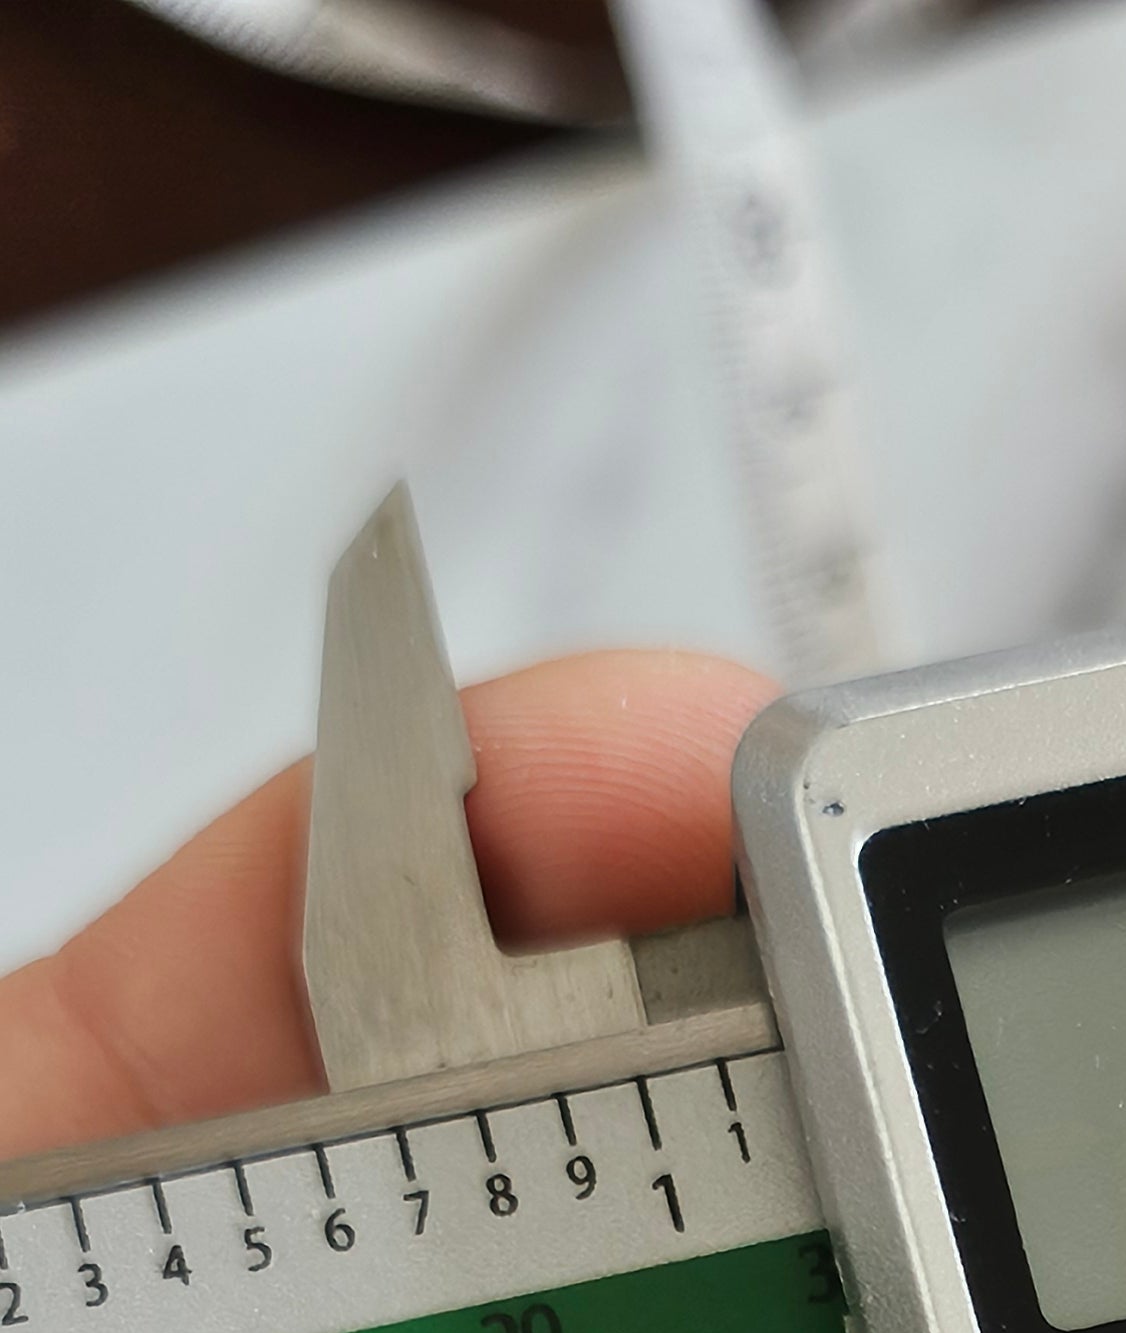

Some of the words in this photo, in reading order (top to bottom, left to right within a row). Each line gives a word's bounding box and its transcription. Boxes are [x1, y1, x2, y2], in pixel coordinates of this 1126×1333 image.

[0, 1282, 29, 1326] 2
[78, 1263, 109, 1307] 3
[162, 1245, 192, 1287] 4
[244, 1227, 273, 1272] 5
[324, 1208, 356, 1252] 6
[403, 1190, 430, 1235] 7
[485, 1173, 519, 1217] 8
[566, 1155, 597, 1199] 9
[651, 1173, 686, 1233] 1
[727, 1121, 751, 1164] 1
